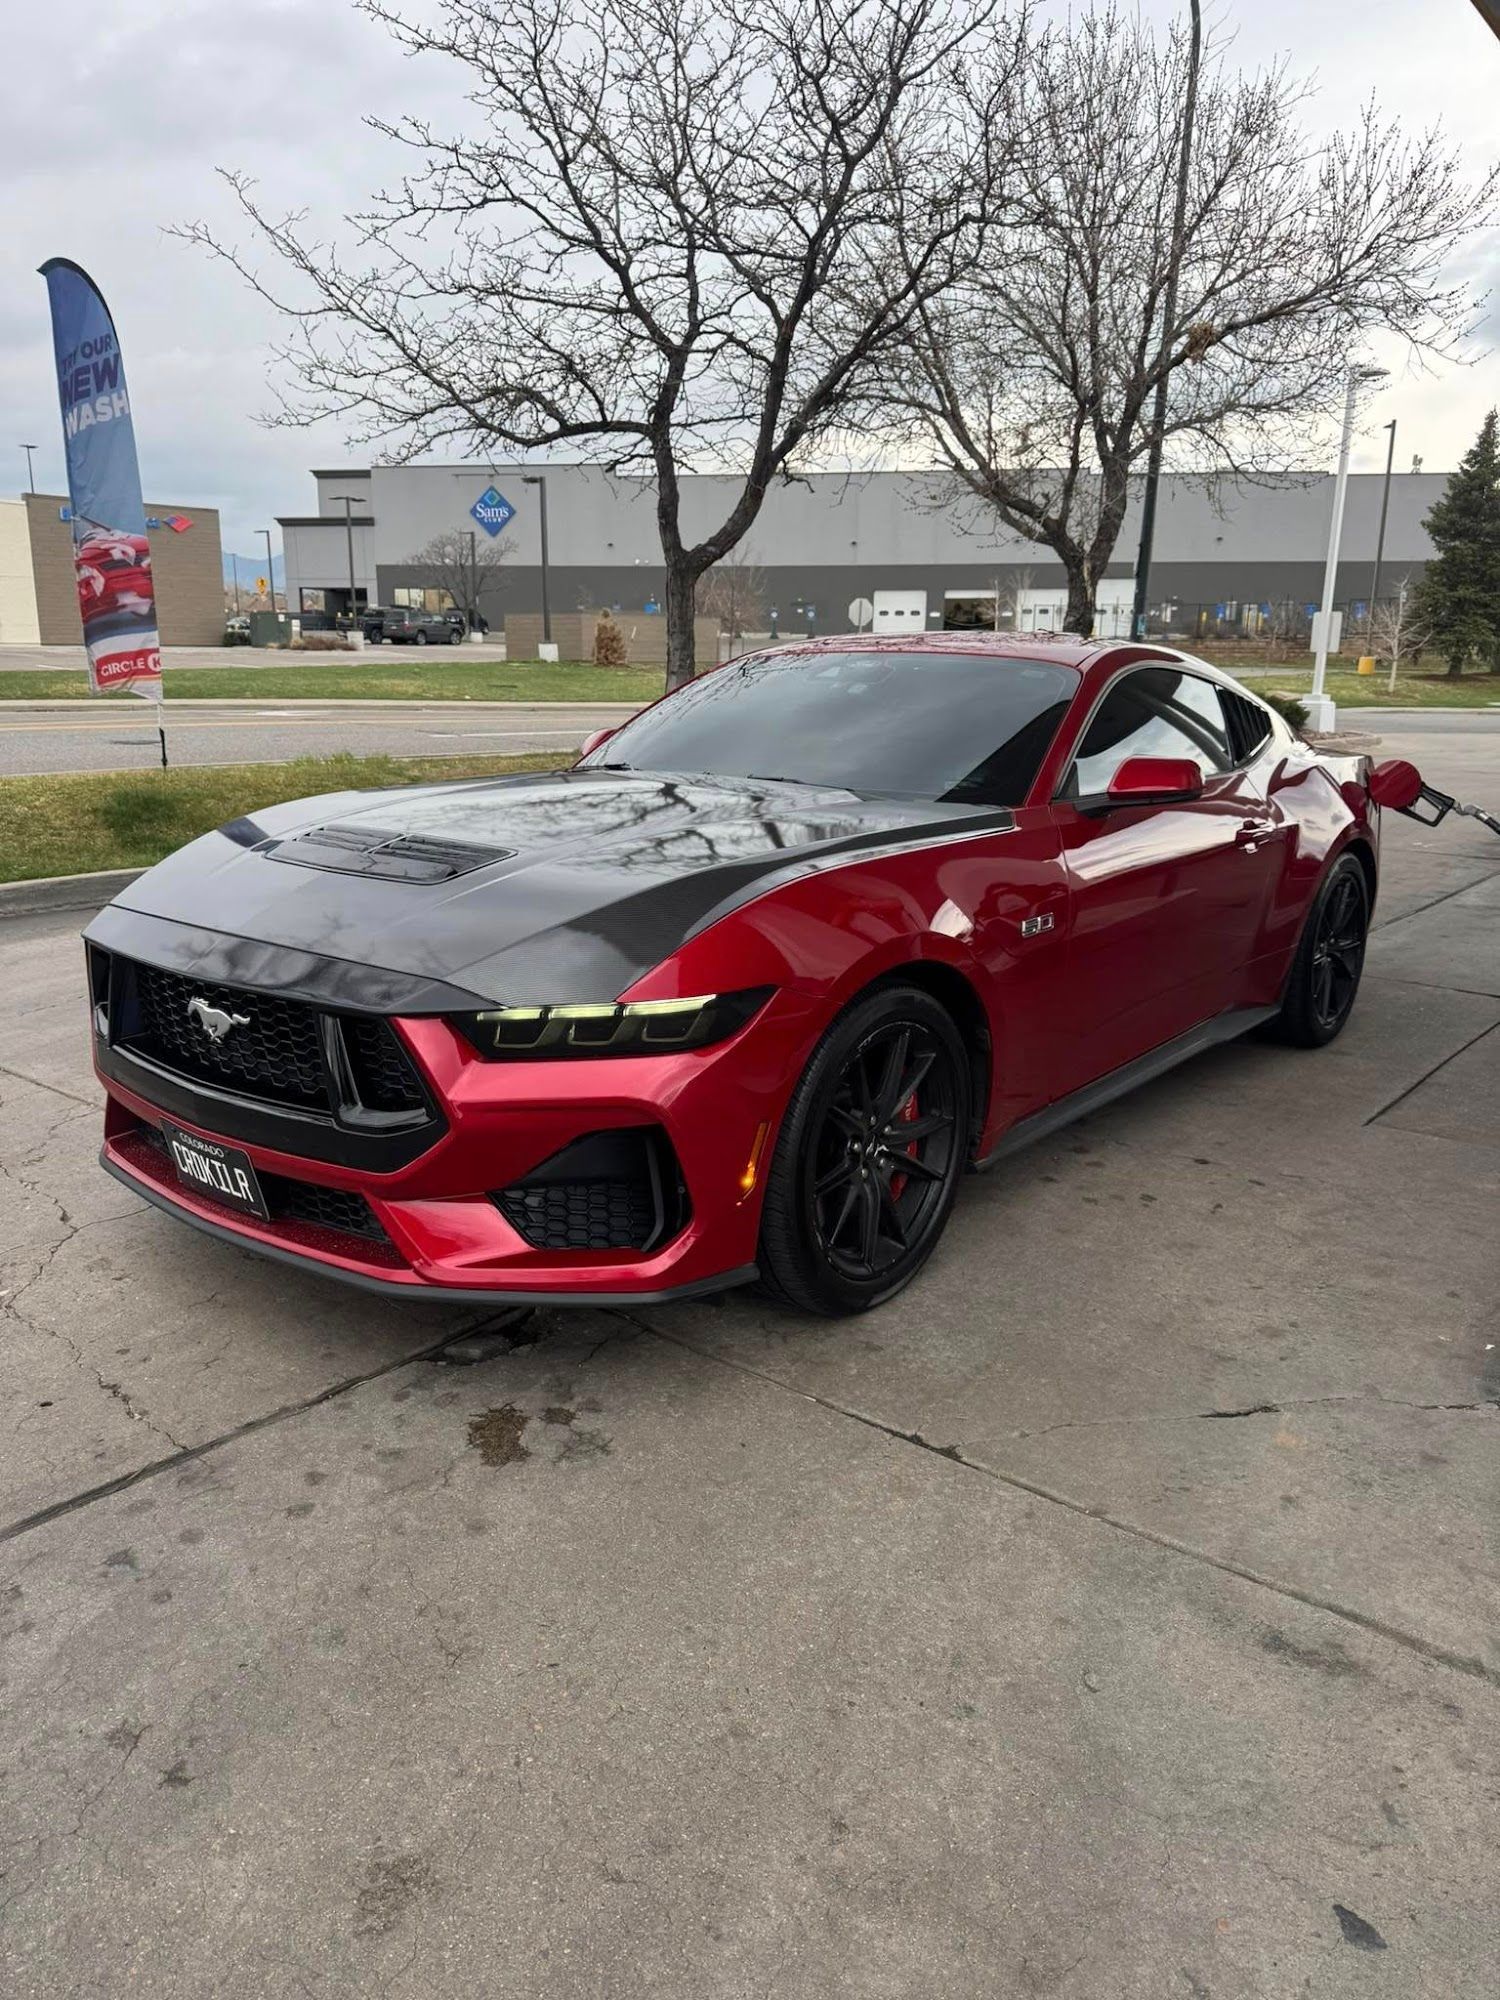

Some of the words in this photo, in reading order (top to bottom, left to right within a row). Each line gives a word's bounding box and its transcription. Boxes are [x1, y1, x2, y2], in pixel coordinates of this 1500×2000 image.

[80, 333, 113, 359] OUR
[62, 353, 120, 411] NEW
[65, 390, 129, 440] WASH
[101, 658, 145, 677] CIRCLE
[180, 1132, 225, 1158] COLORADO
